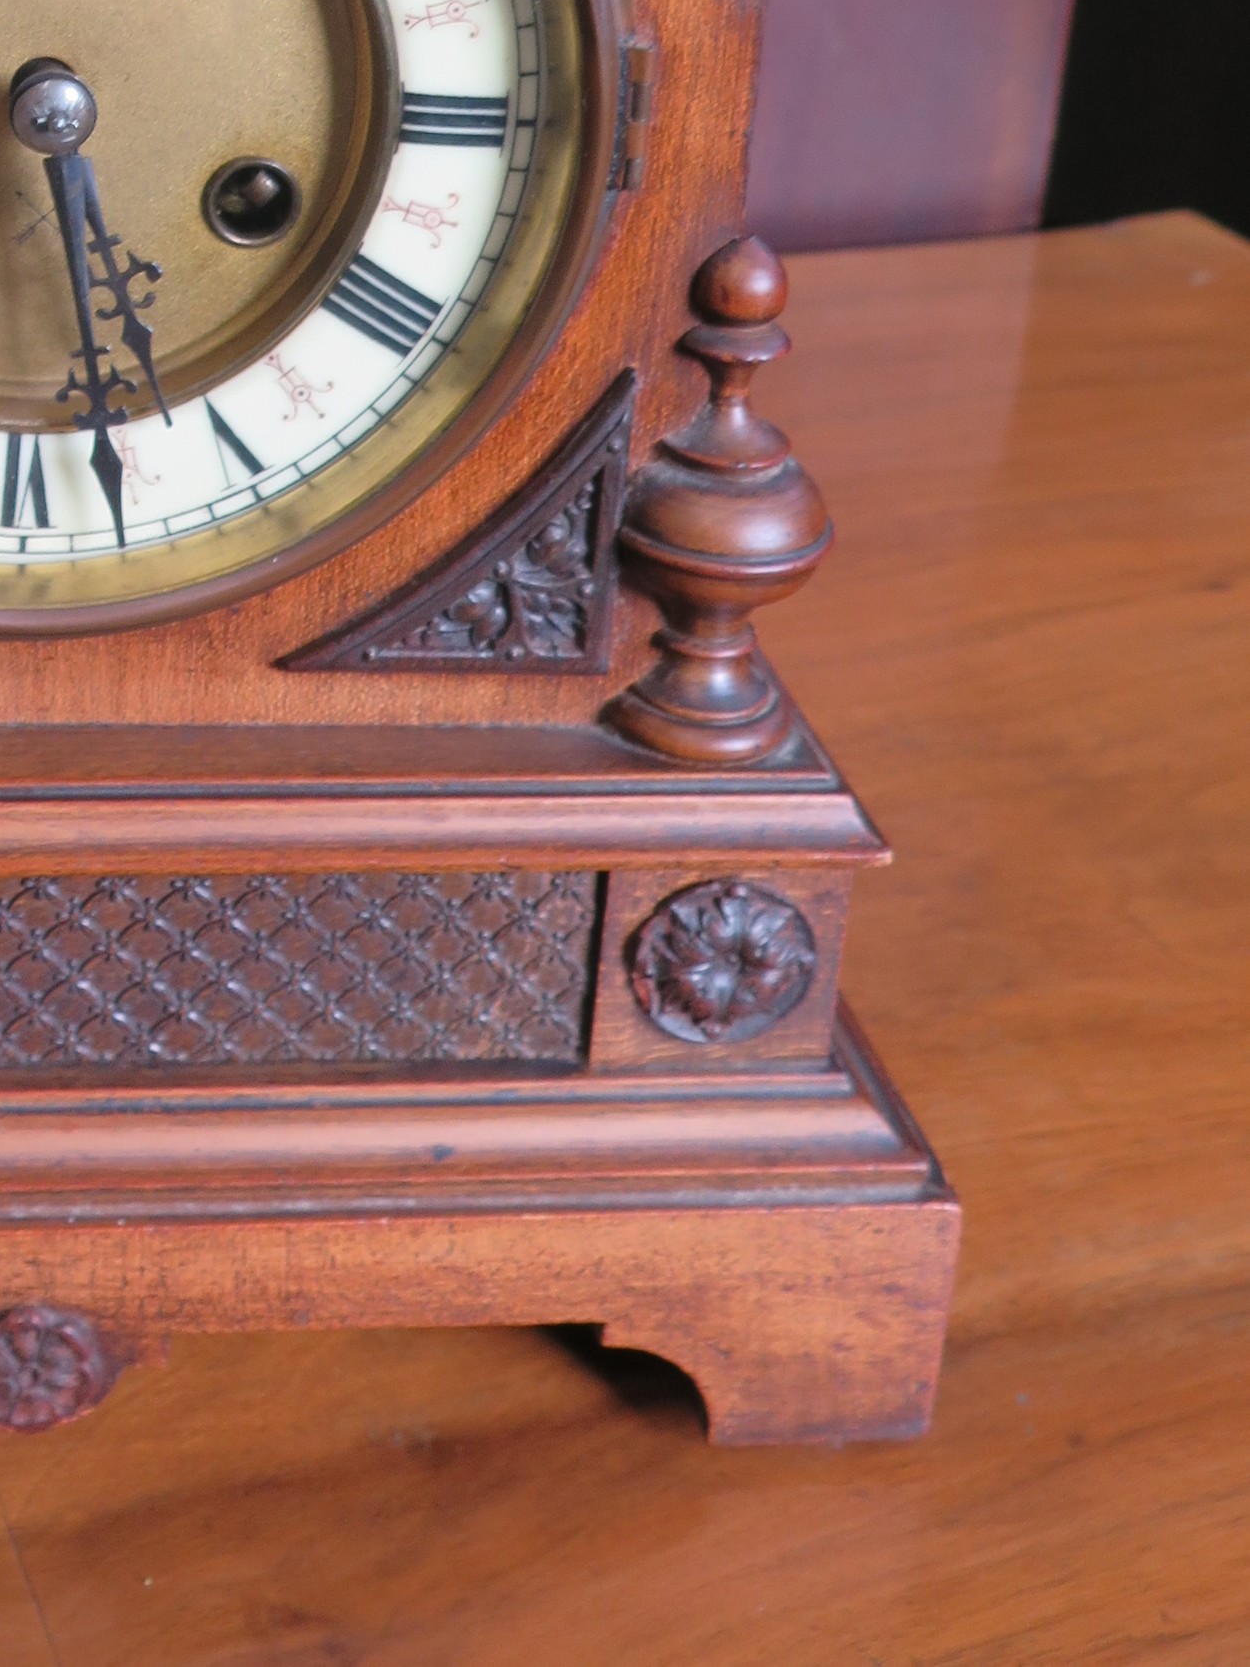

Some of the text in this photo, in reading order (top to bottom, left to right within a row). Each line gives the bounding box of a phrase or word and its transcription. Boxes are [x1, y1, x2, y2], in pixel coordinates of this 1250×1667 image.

[394, 82, 511, 157] III
[320, 241, 450, 368] IIII
[204, 396, 275, 491] V
